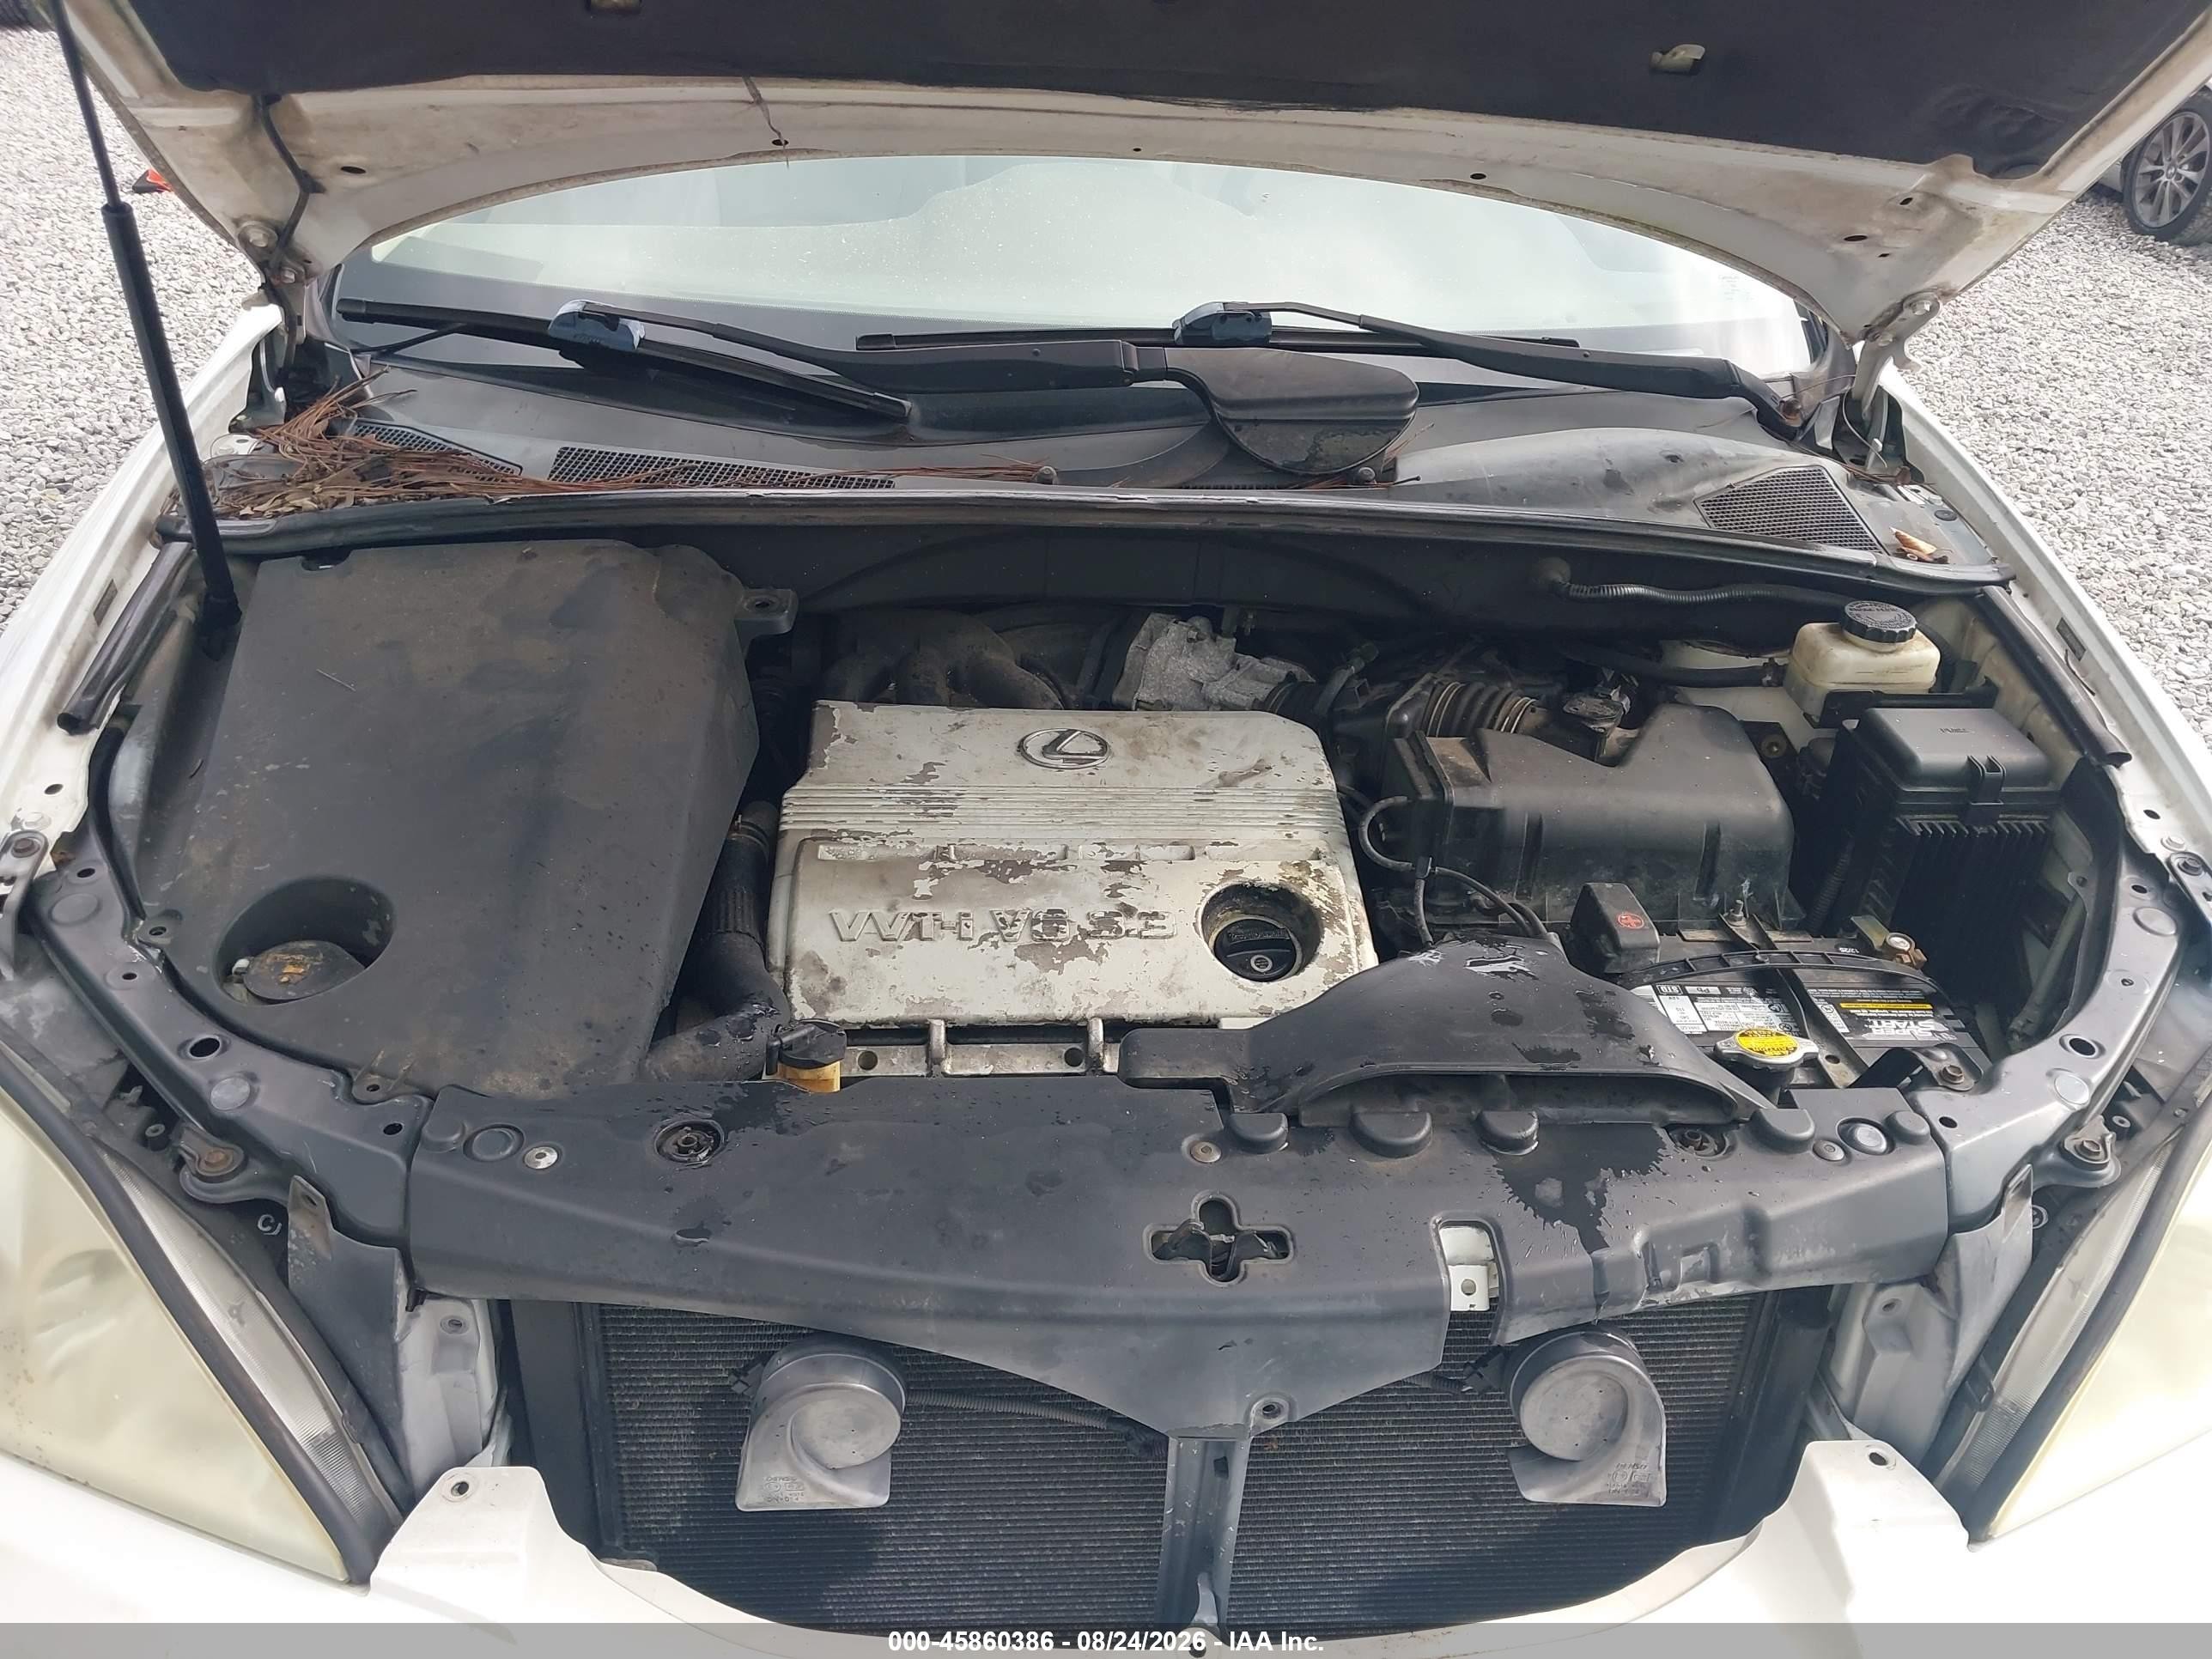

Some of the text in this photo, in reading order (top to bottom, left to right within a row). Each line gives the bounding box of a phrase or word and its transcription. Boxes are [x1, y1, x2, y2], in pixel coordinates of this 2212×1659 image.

[829, 908, 1178, 943] VVT-i V6 3.3
[1869, 1019, 1936, 1030] START
[1872, 1028, 1933, 1037] SUPER
